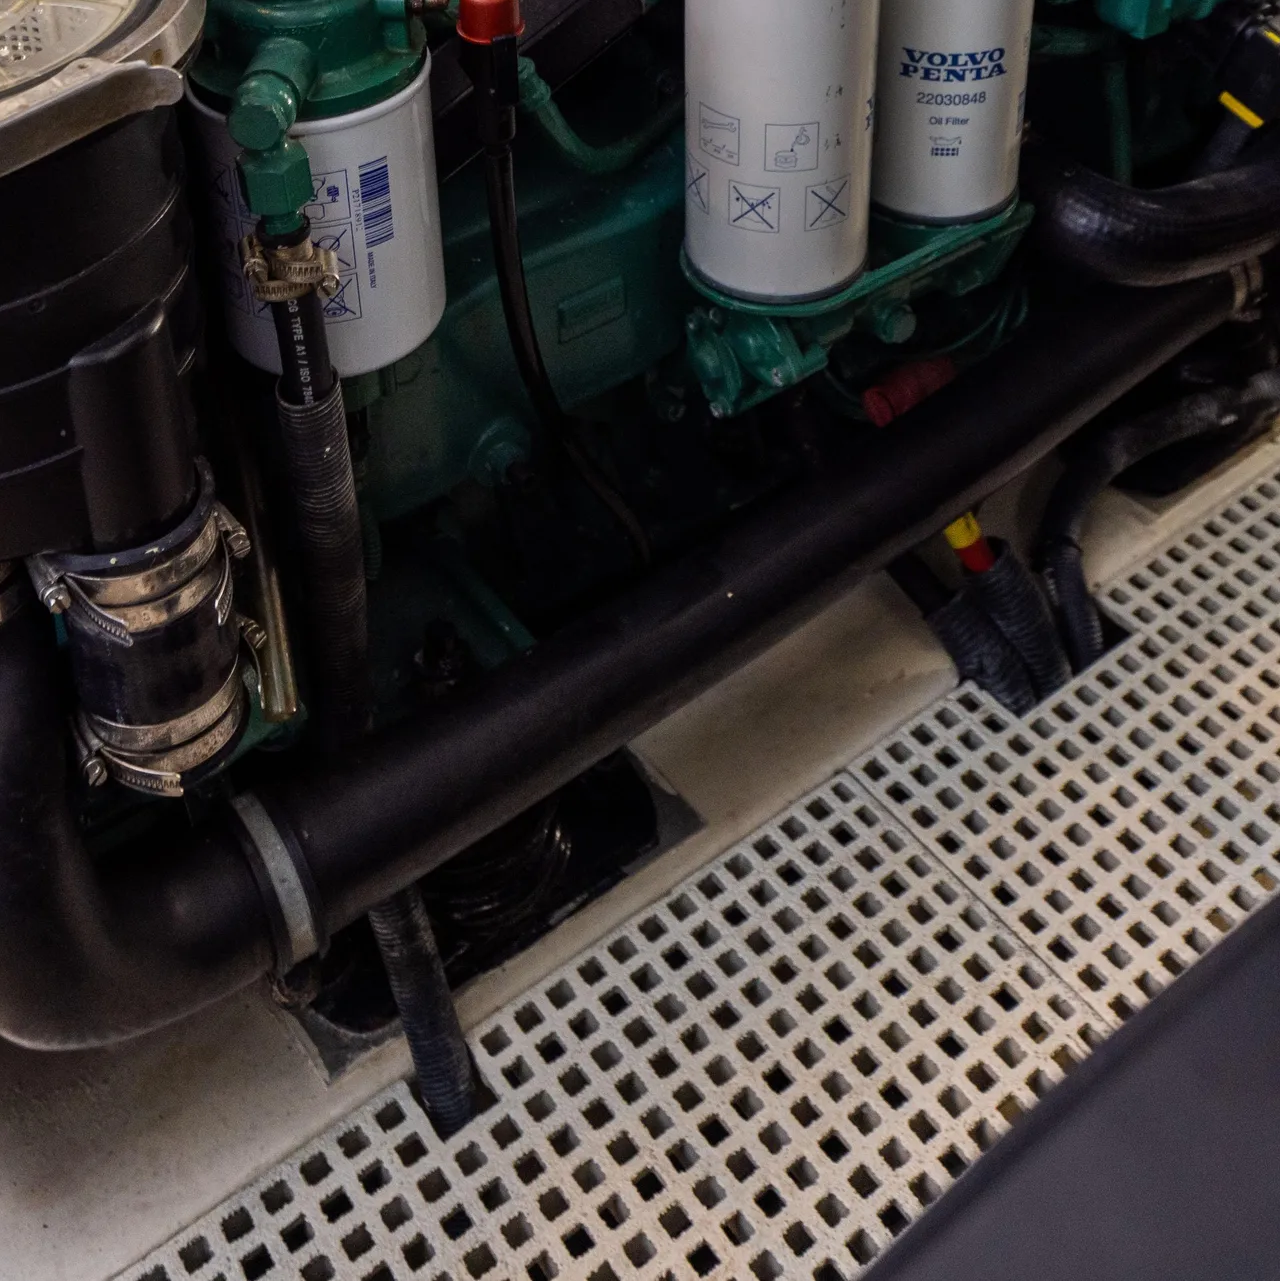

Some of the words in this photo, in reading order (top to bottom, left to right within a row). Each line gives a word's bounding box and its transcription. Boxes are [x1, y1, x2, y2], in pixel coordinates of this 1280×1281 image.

[902, 46, 1006, 67] VOLVO
[900, 62, 1007, 83] PENTA
[916, 91, 987, 107] 22030848
[929, 116, 943, 126] Oil
[945, 116, 970, 126] Filter
[291, 316, 304, 341] TYPE
[300, 367, 311, 383] ISO
